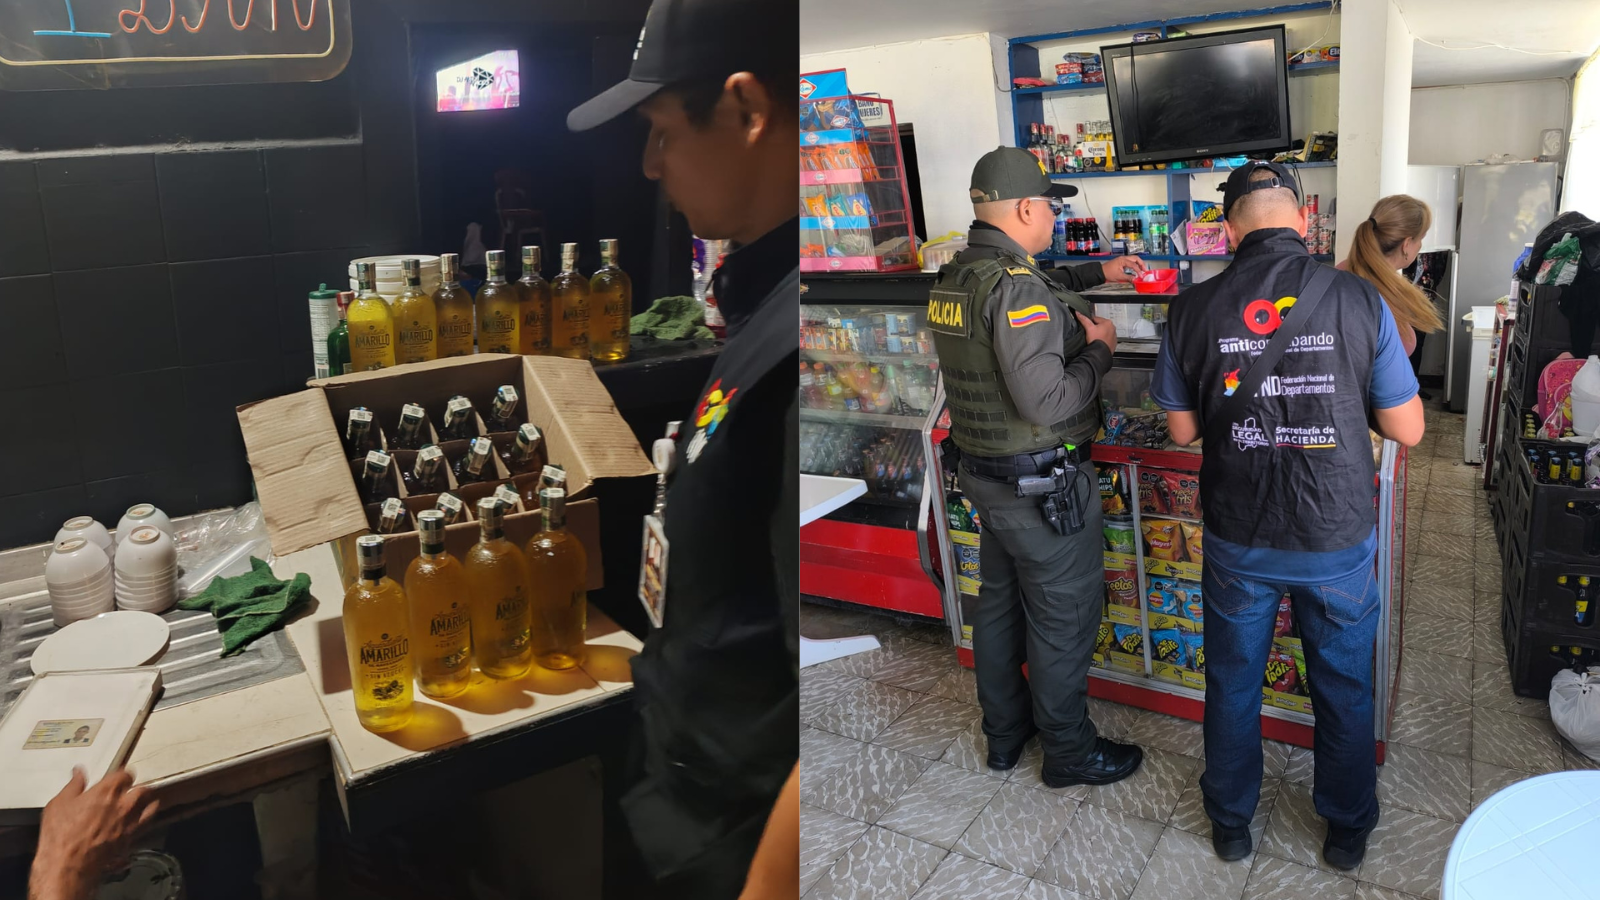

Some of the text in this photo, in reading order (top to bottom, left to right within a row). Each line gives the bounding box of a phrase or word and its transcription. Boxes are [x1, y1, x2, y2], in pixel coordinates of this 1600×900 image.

[927, 300, 963, 327] POLICIA
[355, 333, 390, 349] AMARILLO
[1254, 375, 1281, 398] ND
[1281, 382, 1336, 398] Departamentos
[1232, 430, 1269, 443] LEGAL
[1275, 425, 1335, 435] Secretaría de
[1275, 435, 1336, 444] HACIENDA
[1107, 578, 1134, 591] eetos
[360, 638, 409, 665] AMARILLO
